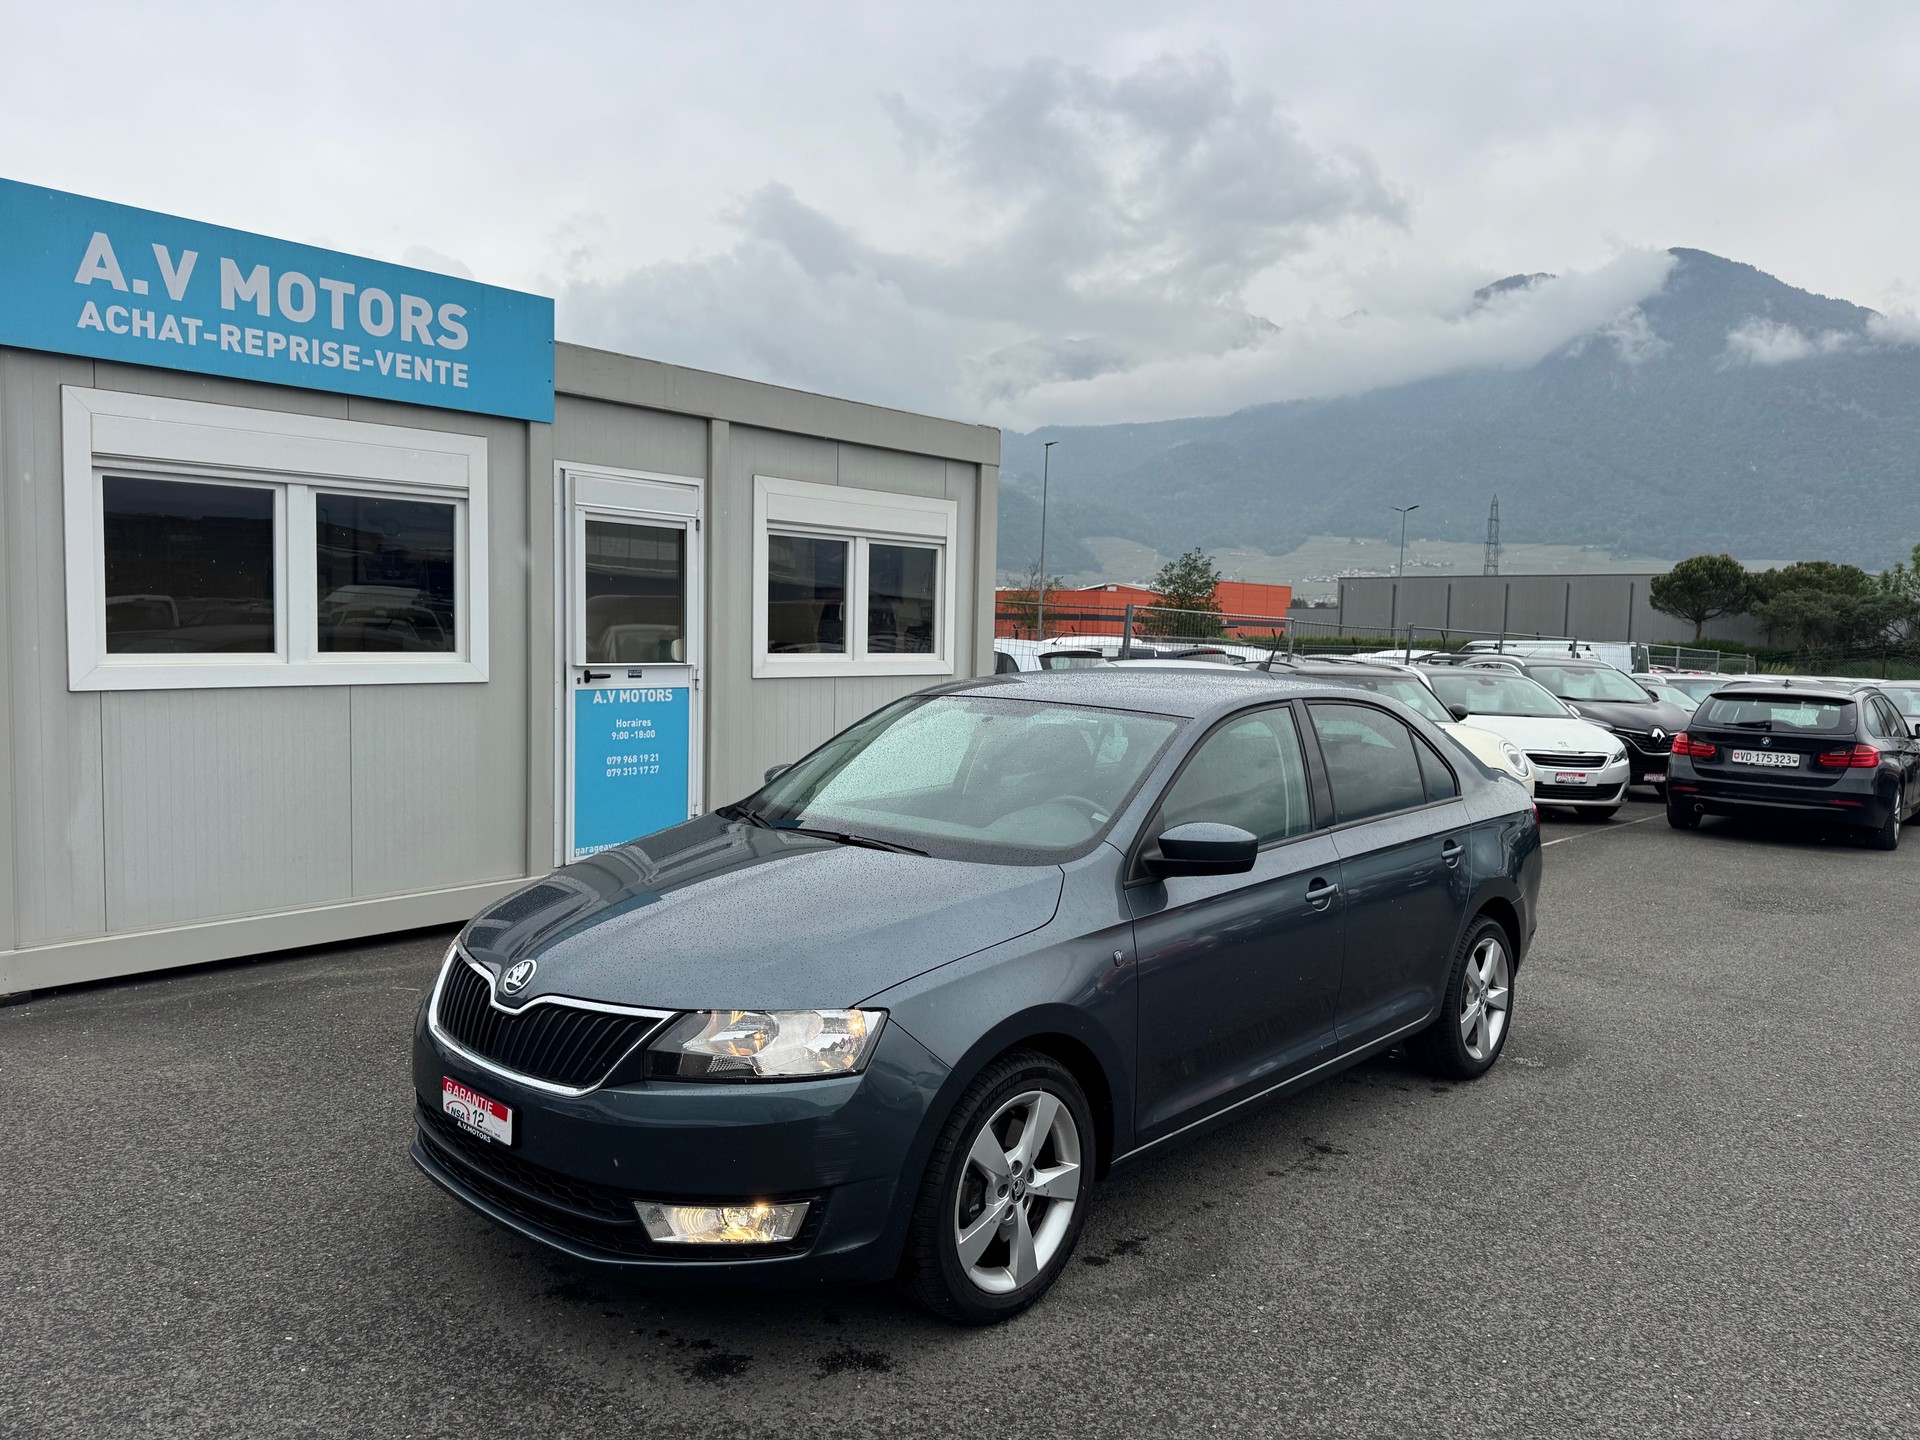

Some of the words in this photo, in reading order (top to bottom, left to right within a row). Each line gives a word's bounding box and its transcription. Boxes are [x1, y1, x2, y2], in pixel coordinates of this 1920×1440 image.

[74, 232, 198, 301] A.V
[220, 257, 469, 350] MOTORS
[77, 301, 469, 388] ACHAT-REPRISE-VENTE
[593, 690, 616, 704] A.V
[619, 689, 673, 703] MOTORS
[616, 718, 652, 728] Horaires
[611, 731, 629, 740] 9:00
[606, 756, 622, 765] 079
[623, 754, 638, 764] 968
[639, 754, 649, 763] 19
[650, 753, 659, 762] 21
[606, 768, 622, 777] 079
[623, 767, 638, 776] 313
[639, 765, 649, 775] 17
[650, 765, 660, 774] 27
[446, 1081, 494, 1115] GARANTIE
[450, 1106, 466, 1121] NSA
[472, 1109, 485, 1129] 12
